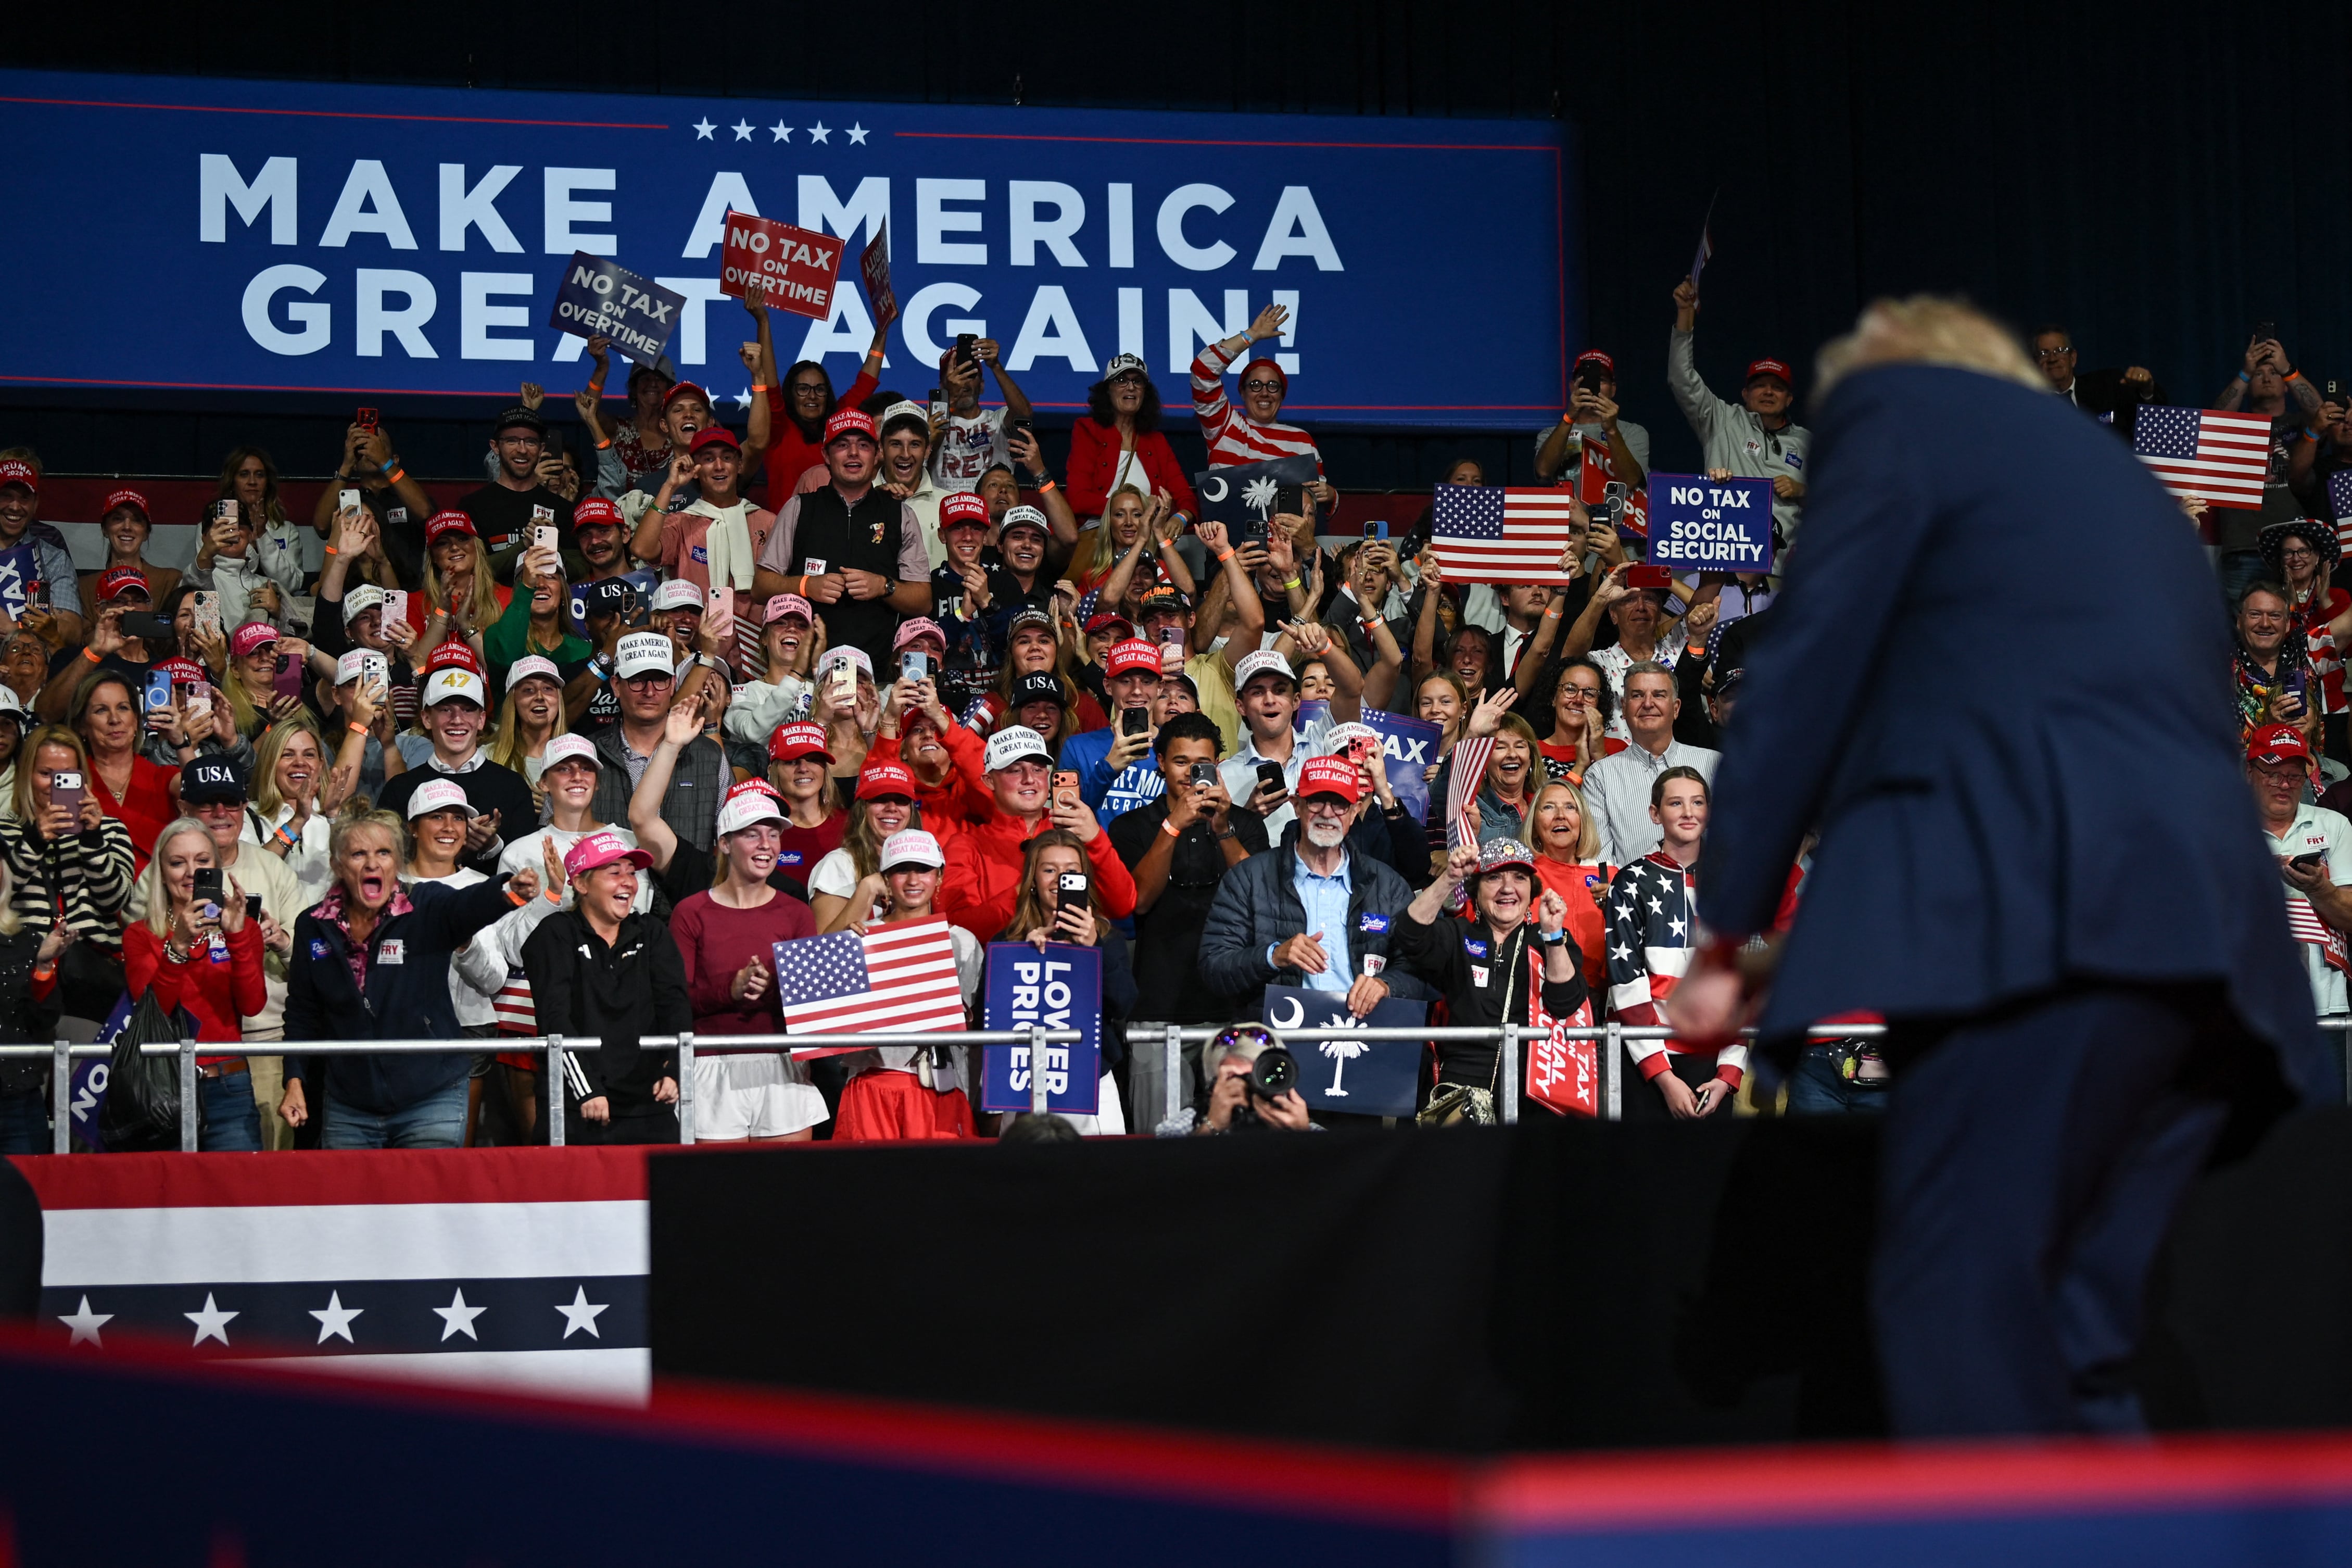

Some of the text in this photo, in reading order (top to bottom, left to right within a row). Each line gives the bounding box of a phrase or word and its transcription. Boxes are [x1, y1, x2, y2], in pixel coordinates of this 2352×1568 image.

[200, 153, 1345, 272] MAKE AMERICA
[730, 227, 833, 271] NO TAX
[763, 260, 788, 275] ON
[725, 267, 827, 307] OVERTIME
[572, 266, 673, 324] NO TAX
[602, 301, 626, 320] ON
[242, 264, 1299, 374] GRET AGAIN!
[559, 302, 659, 356] OVERTIME
[829, 411, 872, 424] MAKE AMERICA
[832, 420, 870, 431] GREAT AGAIN
[1747, 441, 1760, 450] FRY
[944, 495, 984, 508] MAKE AMERICA
[1671, 487, 1751, 509] NO TAX
[389, 510, 403, 519] FRY
[536, 508, 551, 518] FRY
[947, 504, 983, 515] GREAT AGAIN
[1009, 508, 1045, 521] MAKE AMERICA
[1702, 508, 1721, 520] ON
[431, 521, 446, 533] GREAT
[1670, 521, 1751, 542] SOCIAL
[1656, 539, 1764, 562] SECURITY
[807, 562, 822, 572] FRY
[105, 568, 145, 583] TRUMP
[666, 584, 681, 592] MAKE
[348, 590, 363, 603] MAKE
[773, 597, 788, 606] MAKE
[1139, 586, 1175, 605] TRUMP
[352, 597, 370, 609] GREAT
[1013, 612, 1026, 621] MAKE
[906, 619, 921, 628] MAKE
[238, 624, 277, 638] TRUMP
[432, 643, 472, 656] MAKE AMERICA
[620, 638, 669, 651] MAKE AMERICA
[1111, 643, 1159, 657] MAKE AMERICA
[433, 653, 471, 664] GREAT AGAIN
[625, 650, 667, 661] GREAT AGAIN
[1115, 652, 1156, 665] GREAT AGAIN
[1238, 652, 1280, 670] MAKE AMERICA
[174, 662, 203, 675] AMERICA
[516, 658, 532, 667] MAKE
[519, 663, 537, 674] GREAT
[1243, 663, 1259, 676] GREAT
[441, 672, 471, 688] 47
[1025, 676, 1057, 692] USA
[782, 726, 825, 740] MAKE AMERICA
[993, 731, 1043, 747] MAKE AMERICA
[1328, 727, 1345, 740] MAKE
[552, 737, 567, 748] MAKE
[786, 735, 824, 748] GREAT AGAIN
[999, 741, 1042, 755] GREAT AGAIN
[2270, 738, 2302, 747] PATRIOT
[554, 743, 575, 754] GREAT
[196, 766, 235, 783] USA
[864, 766, 908, 777] MAKE AMERICA
[1305, 759, 1357, 777] MAKE AMERICA
[868, 773, 908, 782] GREAT AGAIN
[1308, 770, 1352, 786] GREAT AGAIN
[424, 784, 442, 794] MAKE
[732, 782, 755, 792] MAKE
[427, 790, 449, 800] GREAT
[739, 804, 761, 816] GREAT
[591, 835, 610, 846] MAKE
[887, 835, 932, 849] MAKE AMERICA
[2307, 836, 2325, 845] FRY
[598, 842, 618, 853] GREAT
[889, 844, 930, 857] GREAT AGAIN
[1362, 916, 1387, 927] Darline
[381, 945, 398, 955] FRY
[1043, 962, 1071, 1095] LOWER
[1577, 1053, 1589, 1106] TAX
[71, 1063, 110, 1123] NO
